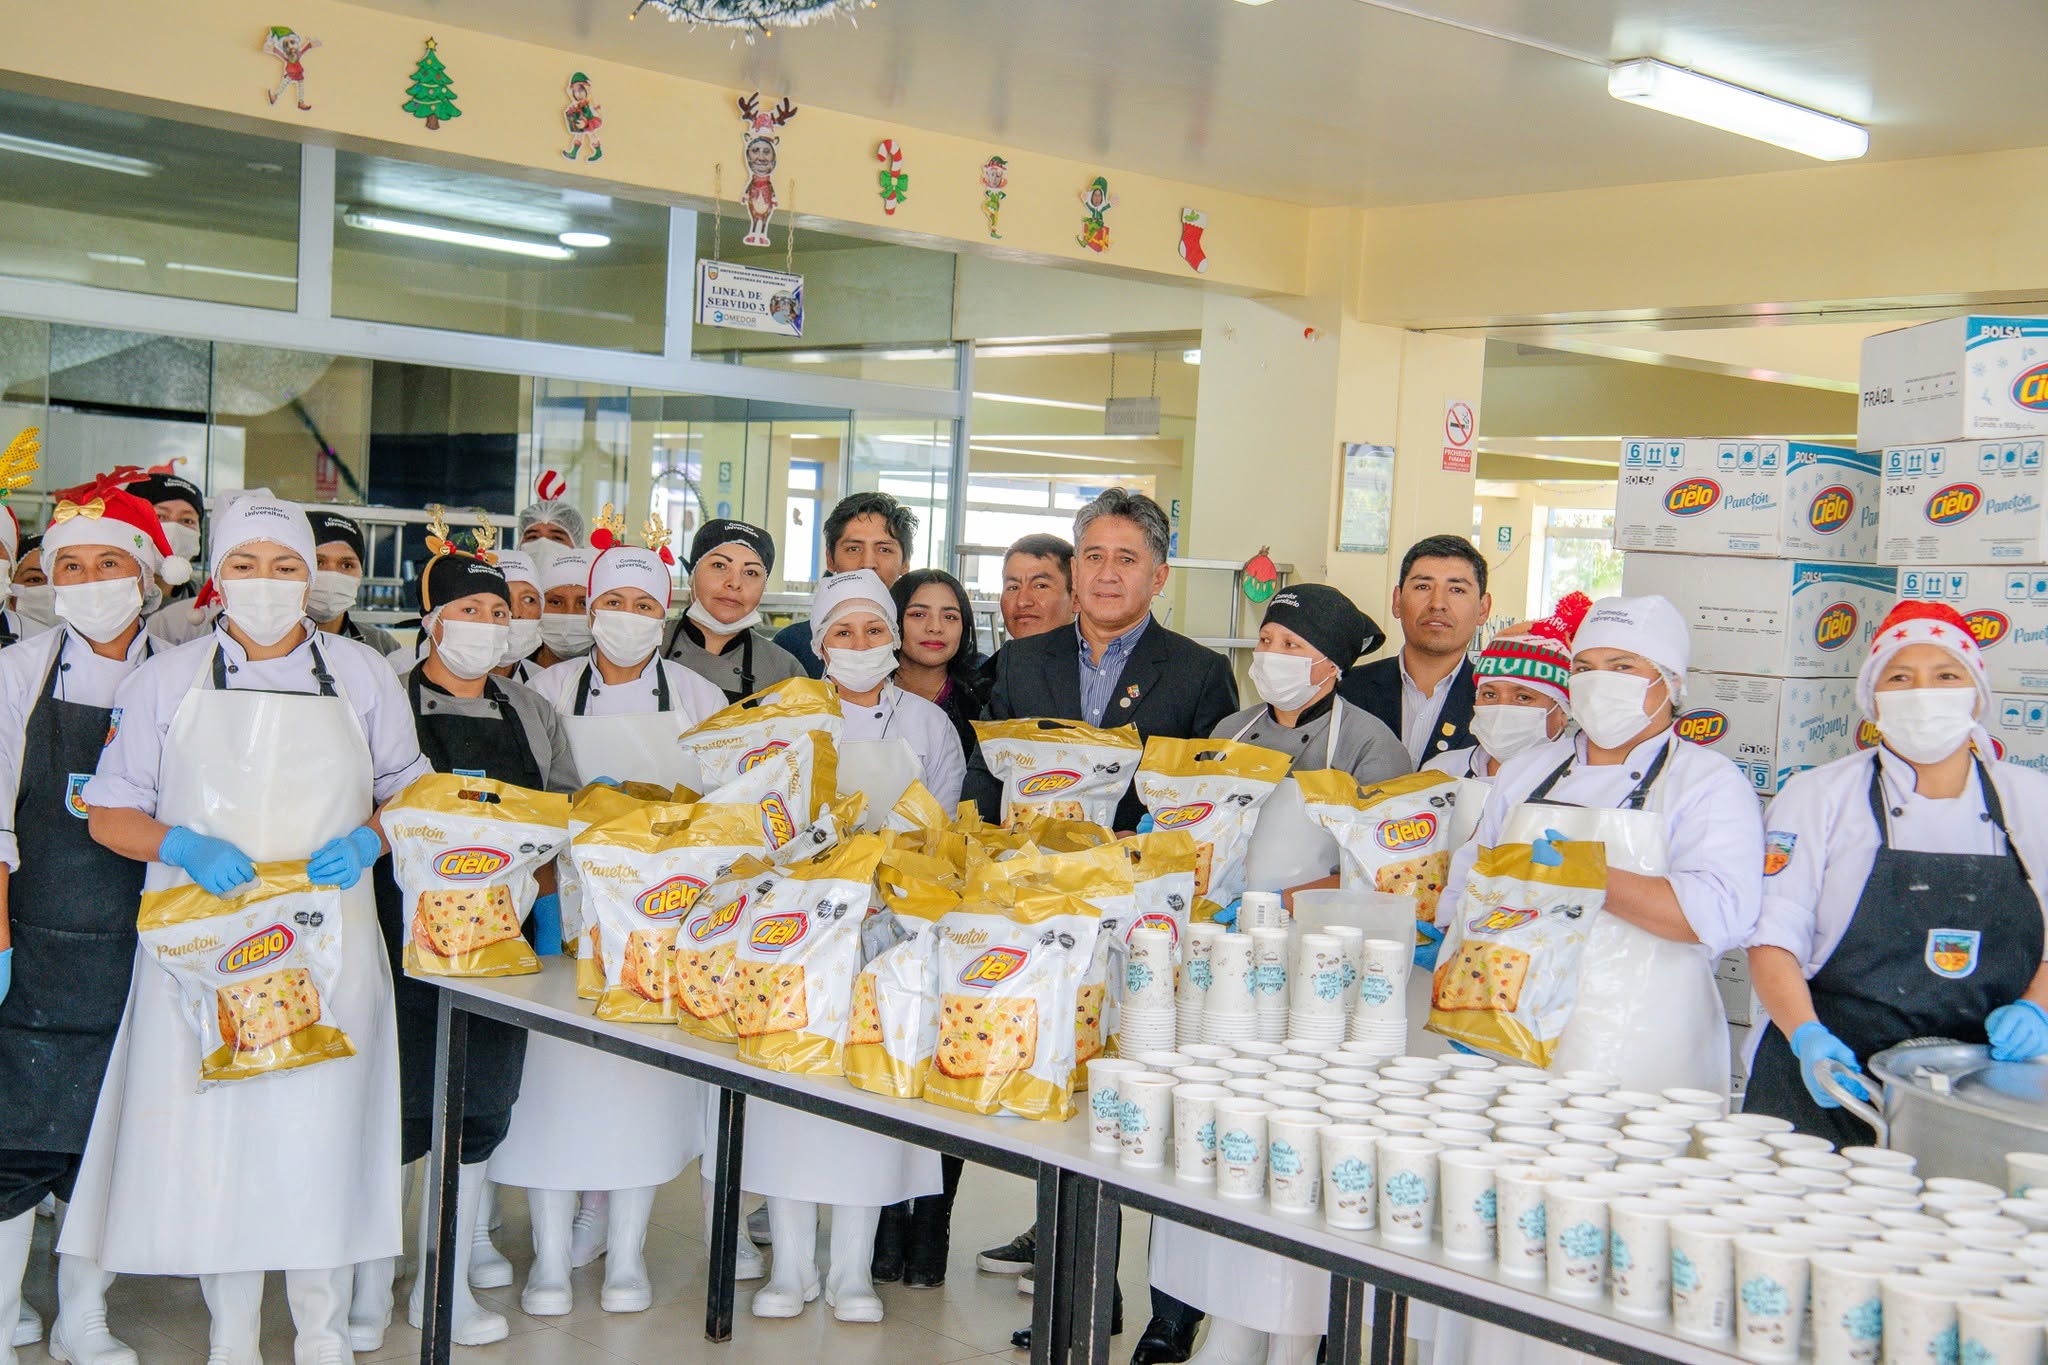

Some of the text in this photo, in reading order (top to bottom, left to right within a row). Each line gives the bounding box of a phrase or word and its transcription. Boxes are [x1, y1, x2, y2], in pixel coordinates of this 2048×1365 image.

[712, 286, 762, 300] LINEA DE
[707, 297, 766, 312] SERVIDO 3
[1981, 326, 2022, 338] BOLSA
[1863, 386, 1894, 408] FRÁGIL
[1631, 445, 1640, 458] 6
[1891, 453, 1900, 467] 6
[720, 463, 731, 481] S
[1669, 488, 1713, 511] Cielo
[1723, 492, 1769, 510] Panetón
[1930, 491, 1974, 519] Cielo
[1986, 495, 2032, 515] Panetón
[245, 510, 290, 520] Universitario
[1812, 497, 1848, 526] Cielo
[1500, 528, 1510, 541] S
[1907, 575, 1917, 588] 6
[1818, 613, 1851, 642] Cielo
[1680, 716, 1723, 739] Cielo
[1384, 820, 1432, 847] Cielo
[440, 853, 502, 875] Cielo
[157, 933, 220, 959] Panetón
[250, 936, 262, 946] Del
[227, 933, 284, 971] Cielo
